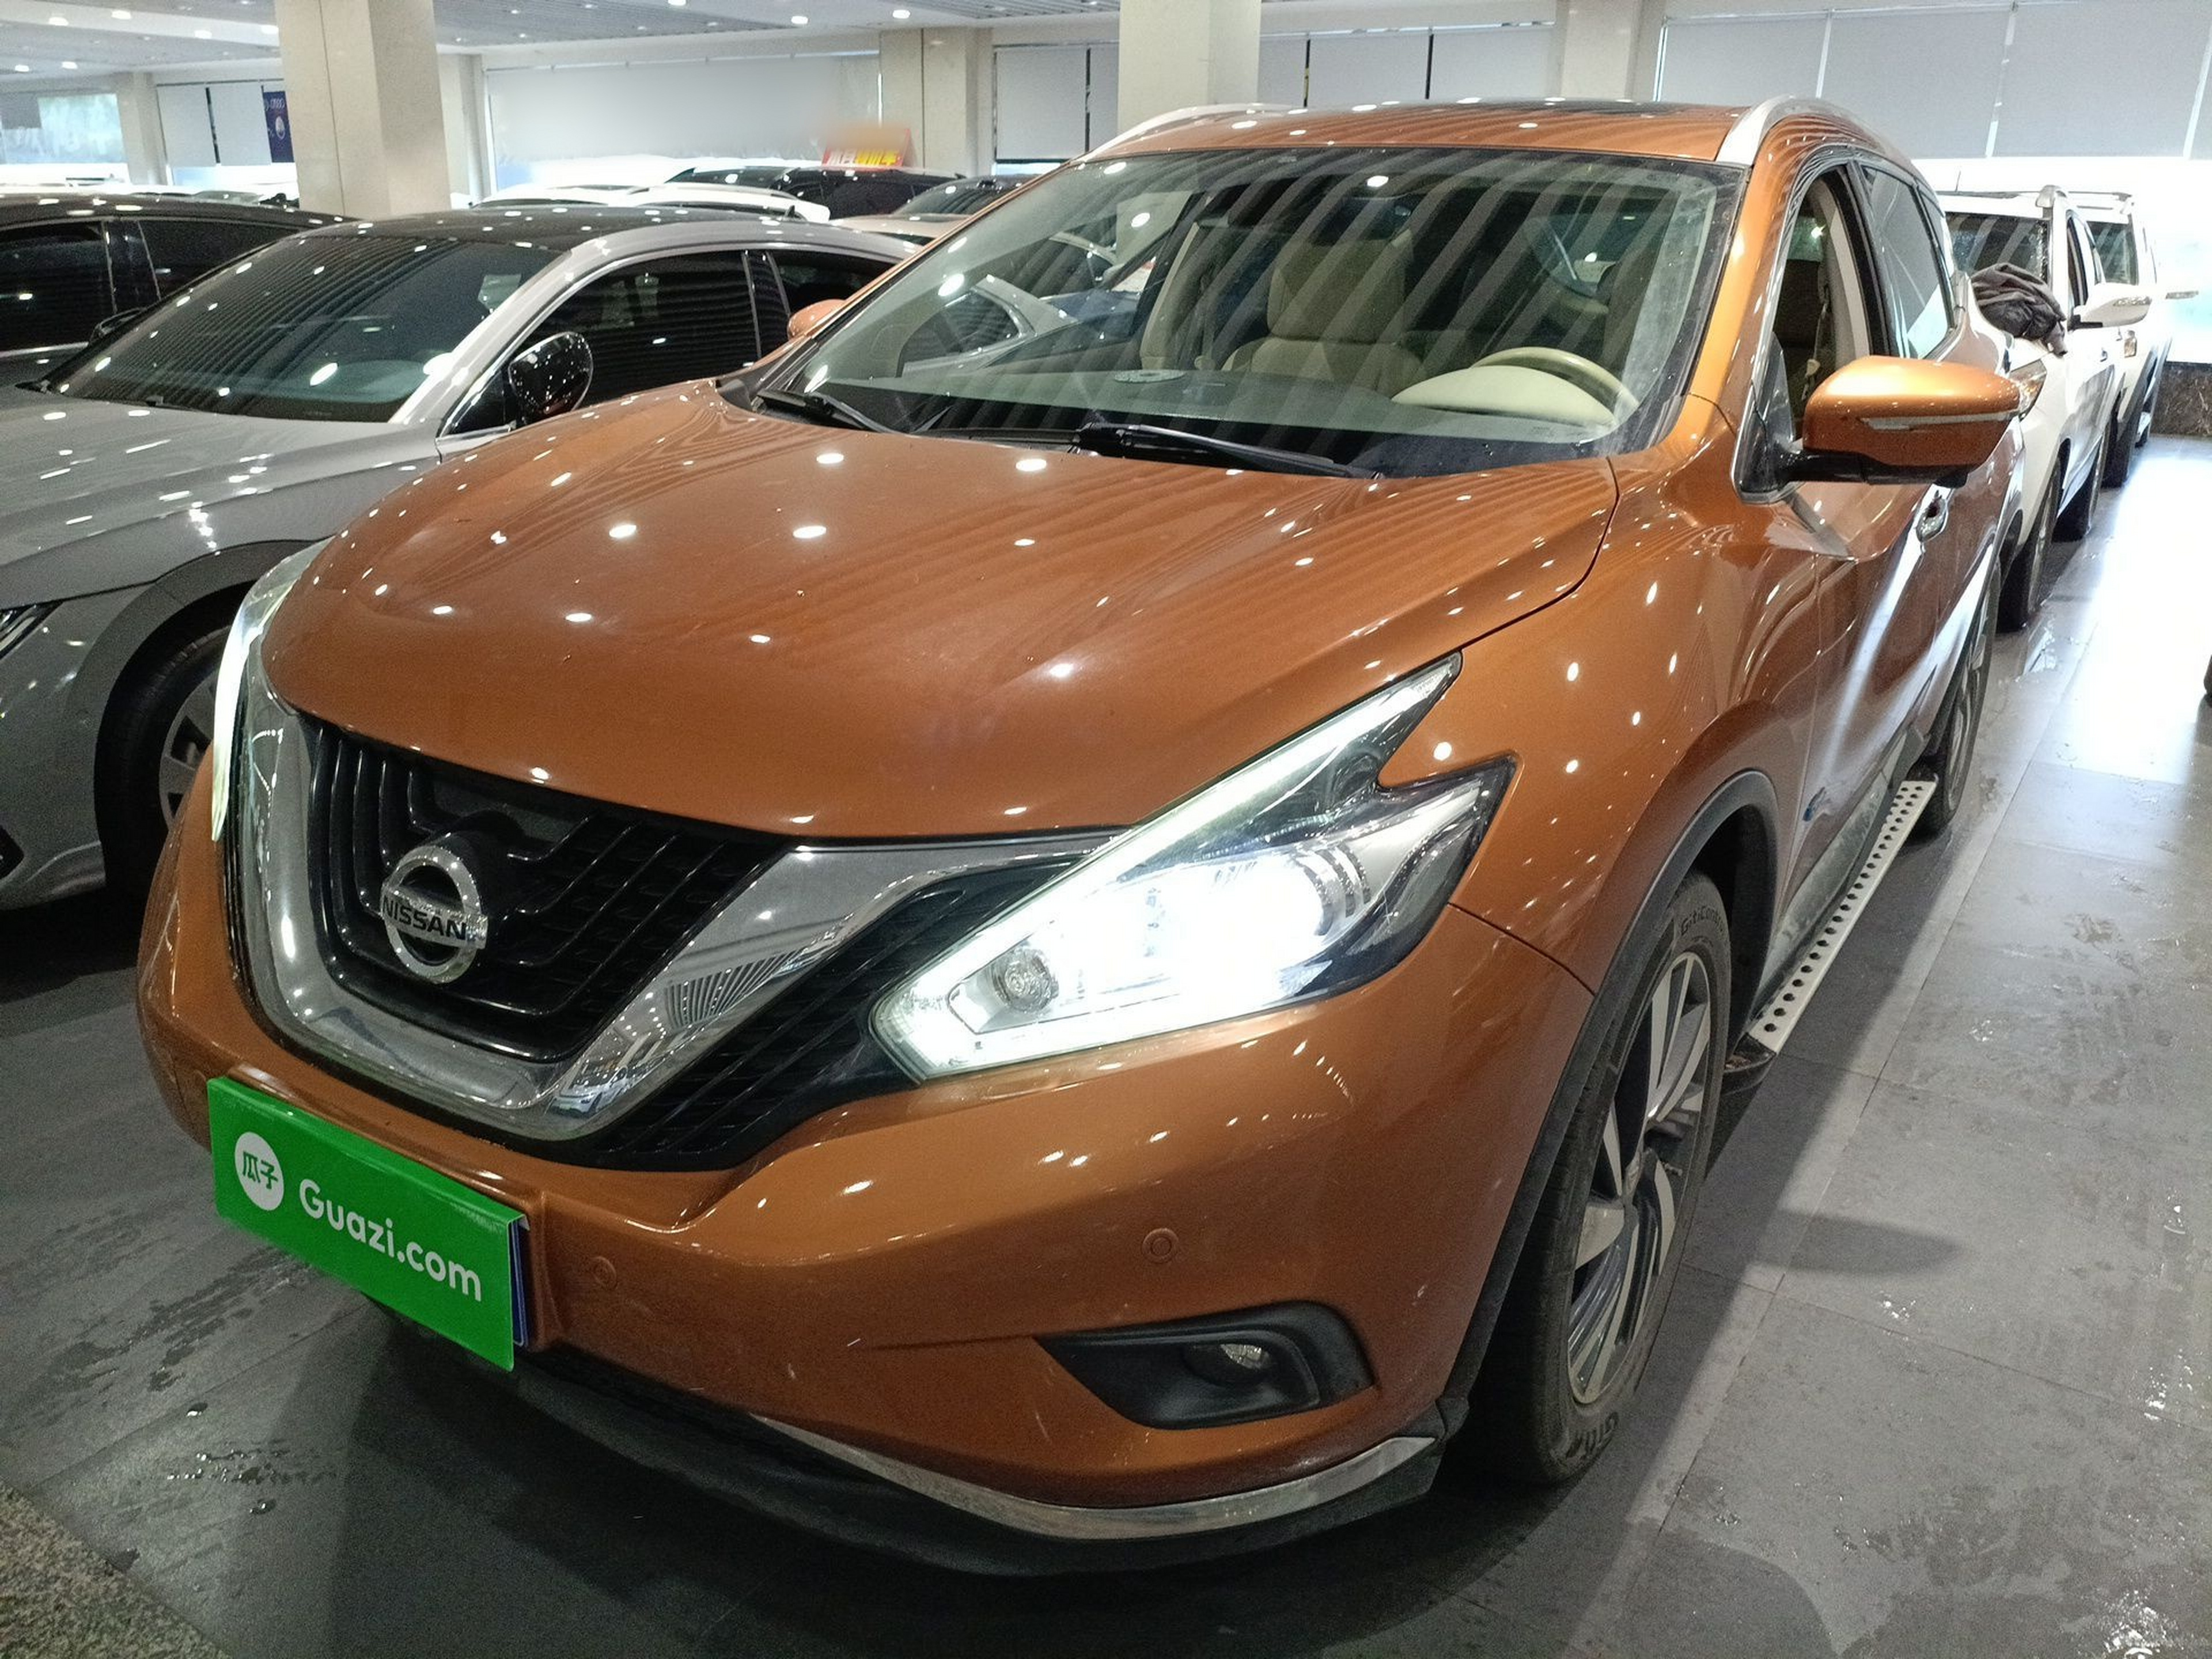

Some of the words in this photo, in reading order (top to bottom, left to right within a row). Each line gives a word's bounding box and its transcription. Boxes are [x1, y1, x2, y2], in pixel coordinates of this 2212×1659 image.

[382, 894, 467, 941] NISSAN
[242, 1151, 279, 1190] 瓜子
[299, 1179, 482, 1302] Guazi.com
